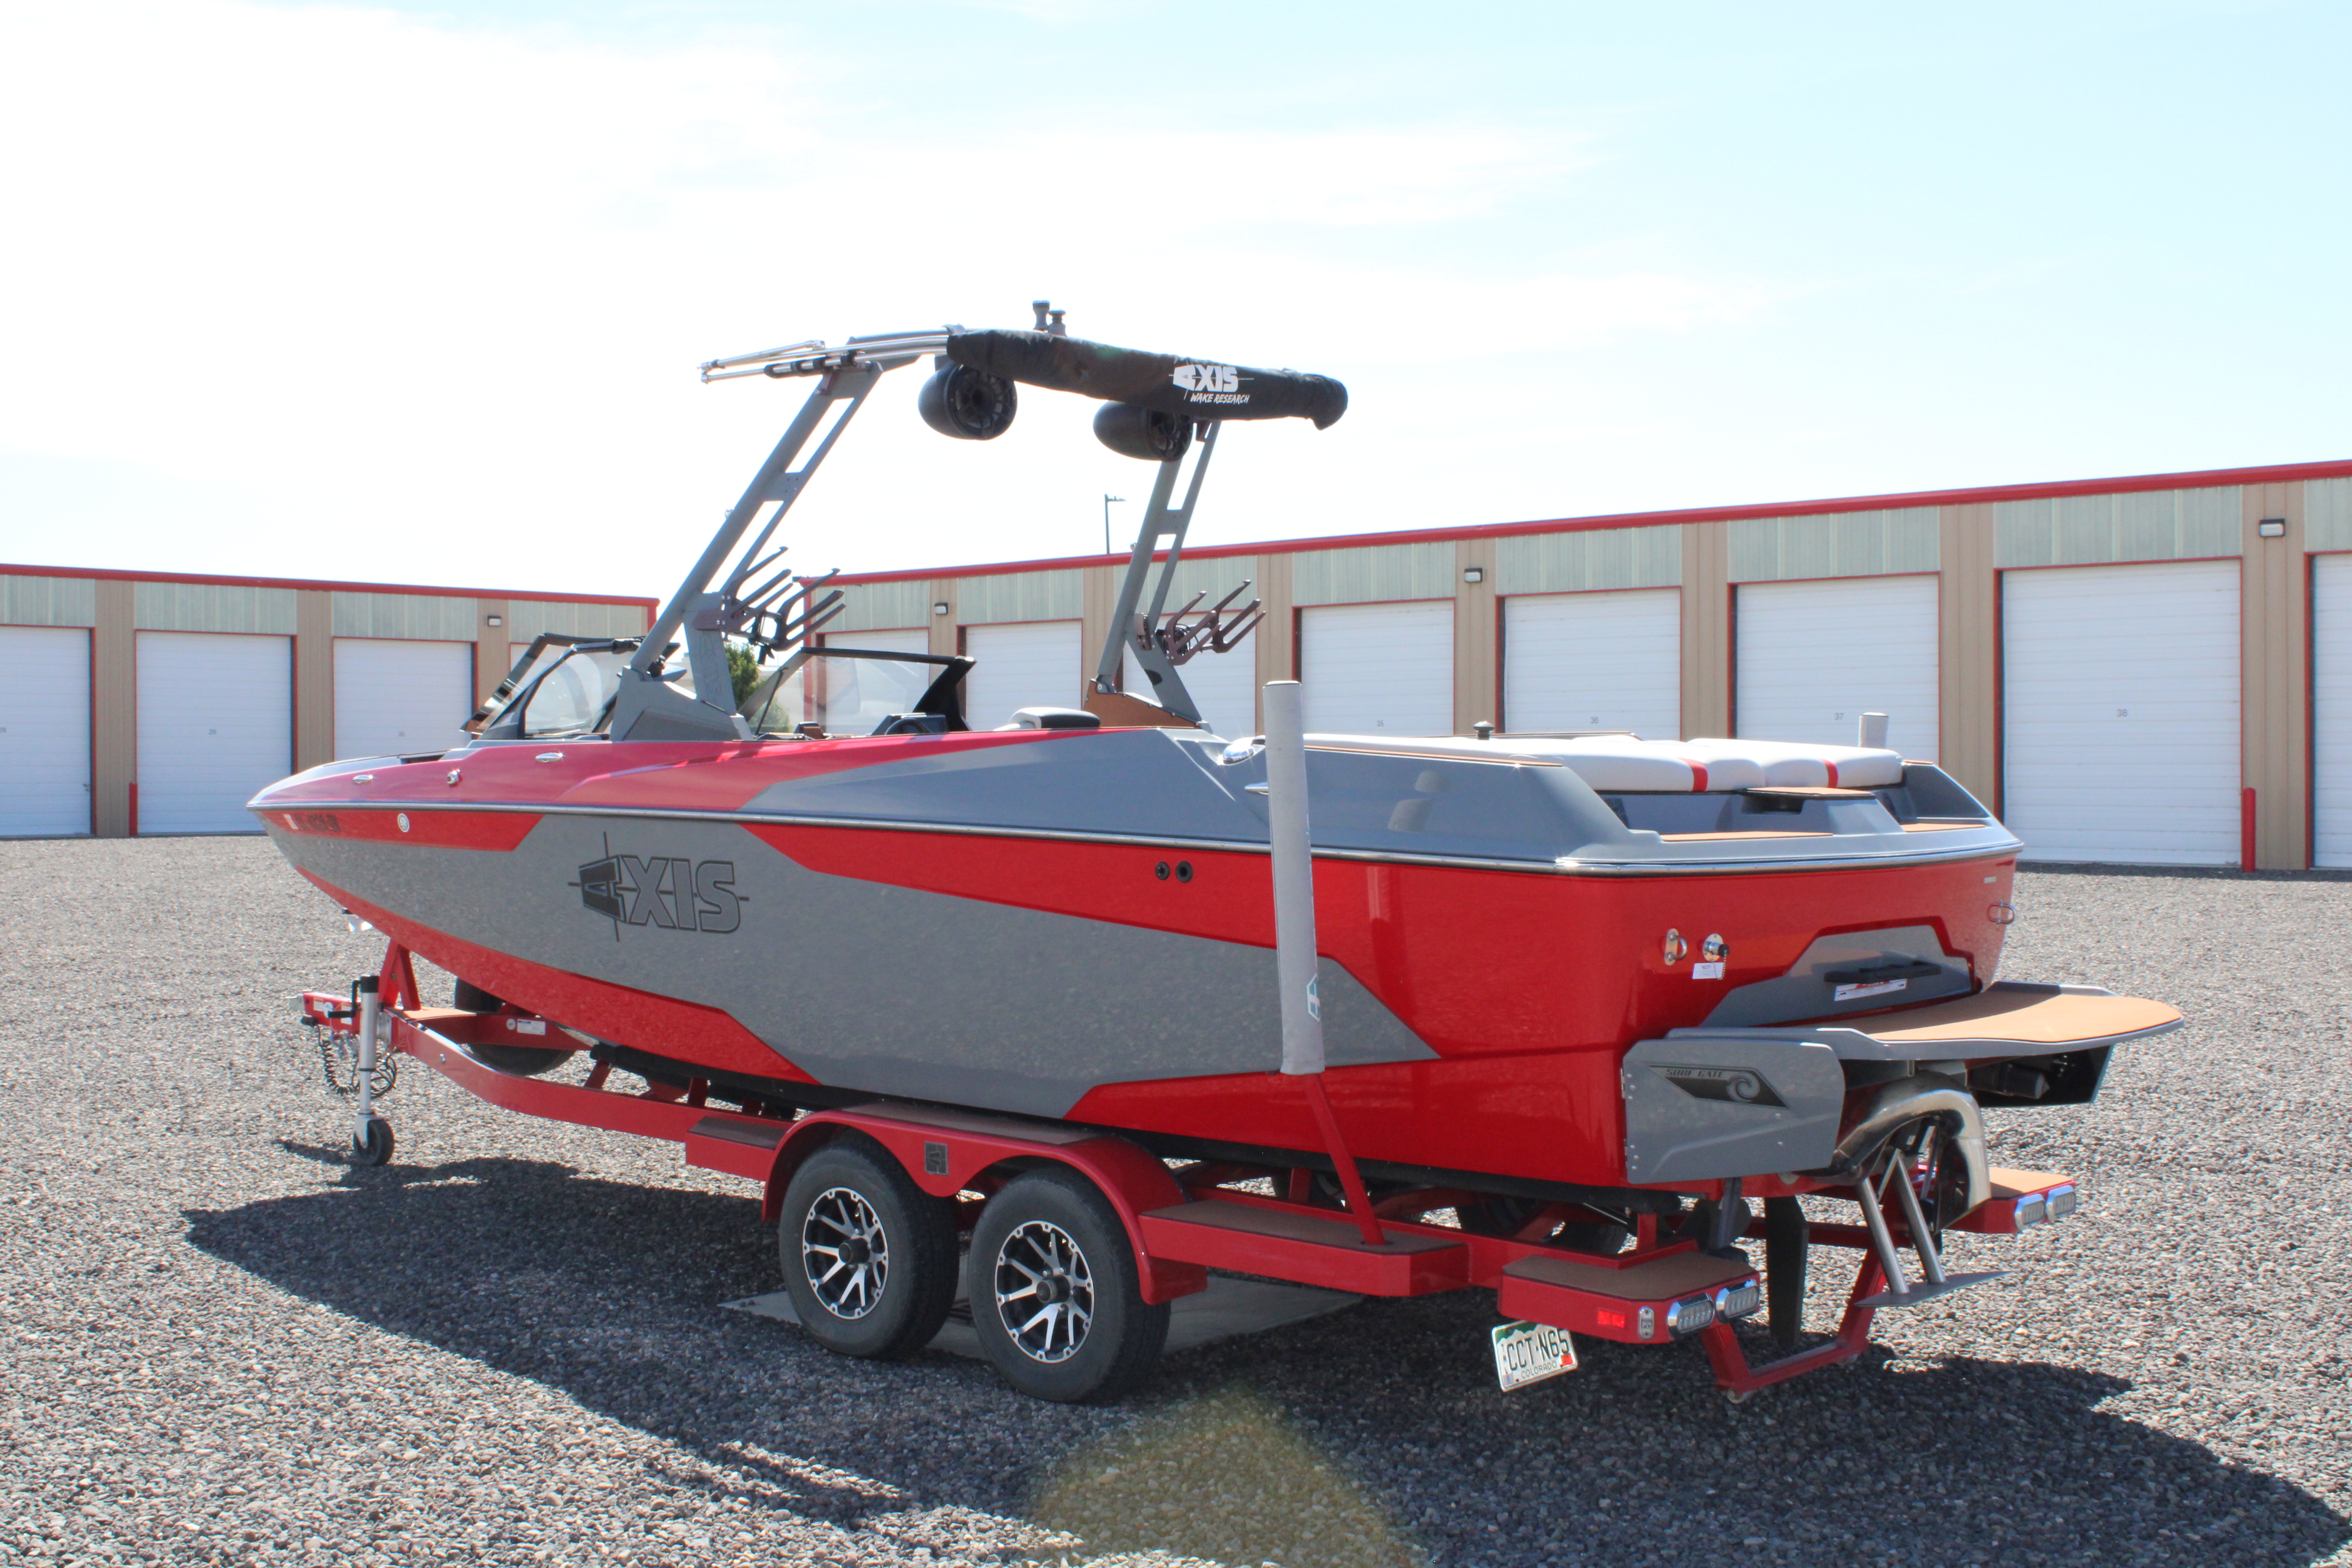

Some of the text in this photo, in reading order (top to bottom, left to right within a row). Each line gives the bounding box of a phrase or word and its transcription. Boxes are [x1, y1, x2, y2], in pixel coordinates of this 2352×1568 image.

[1173, 364, 1239, 393] AXIS
[1190, 393, 1250, 405] WAKE RESEARCH
[579, 854, 741, 934] AXIS
[1521, 1360, 1557, 1379] COLORADO
